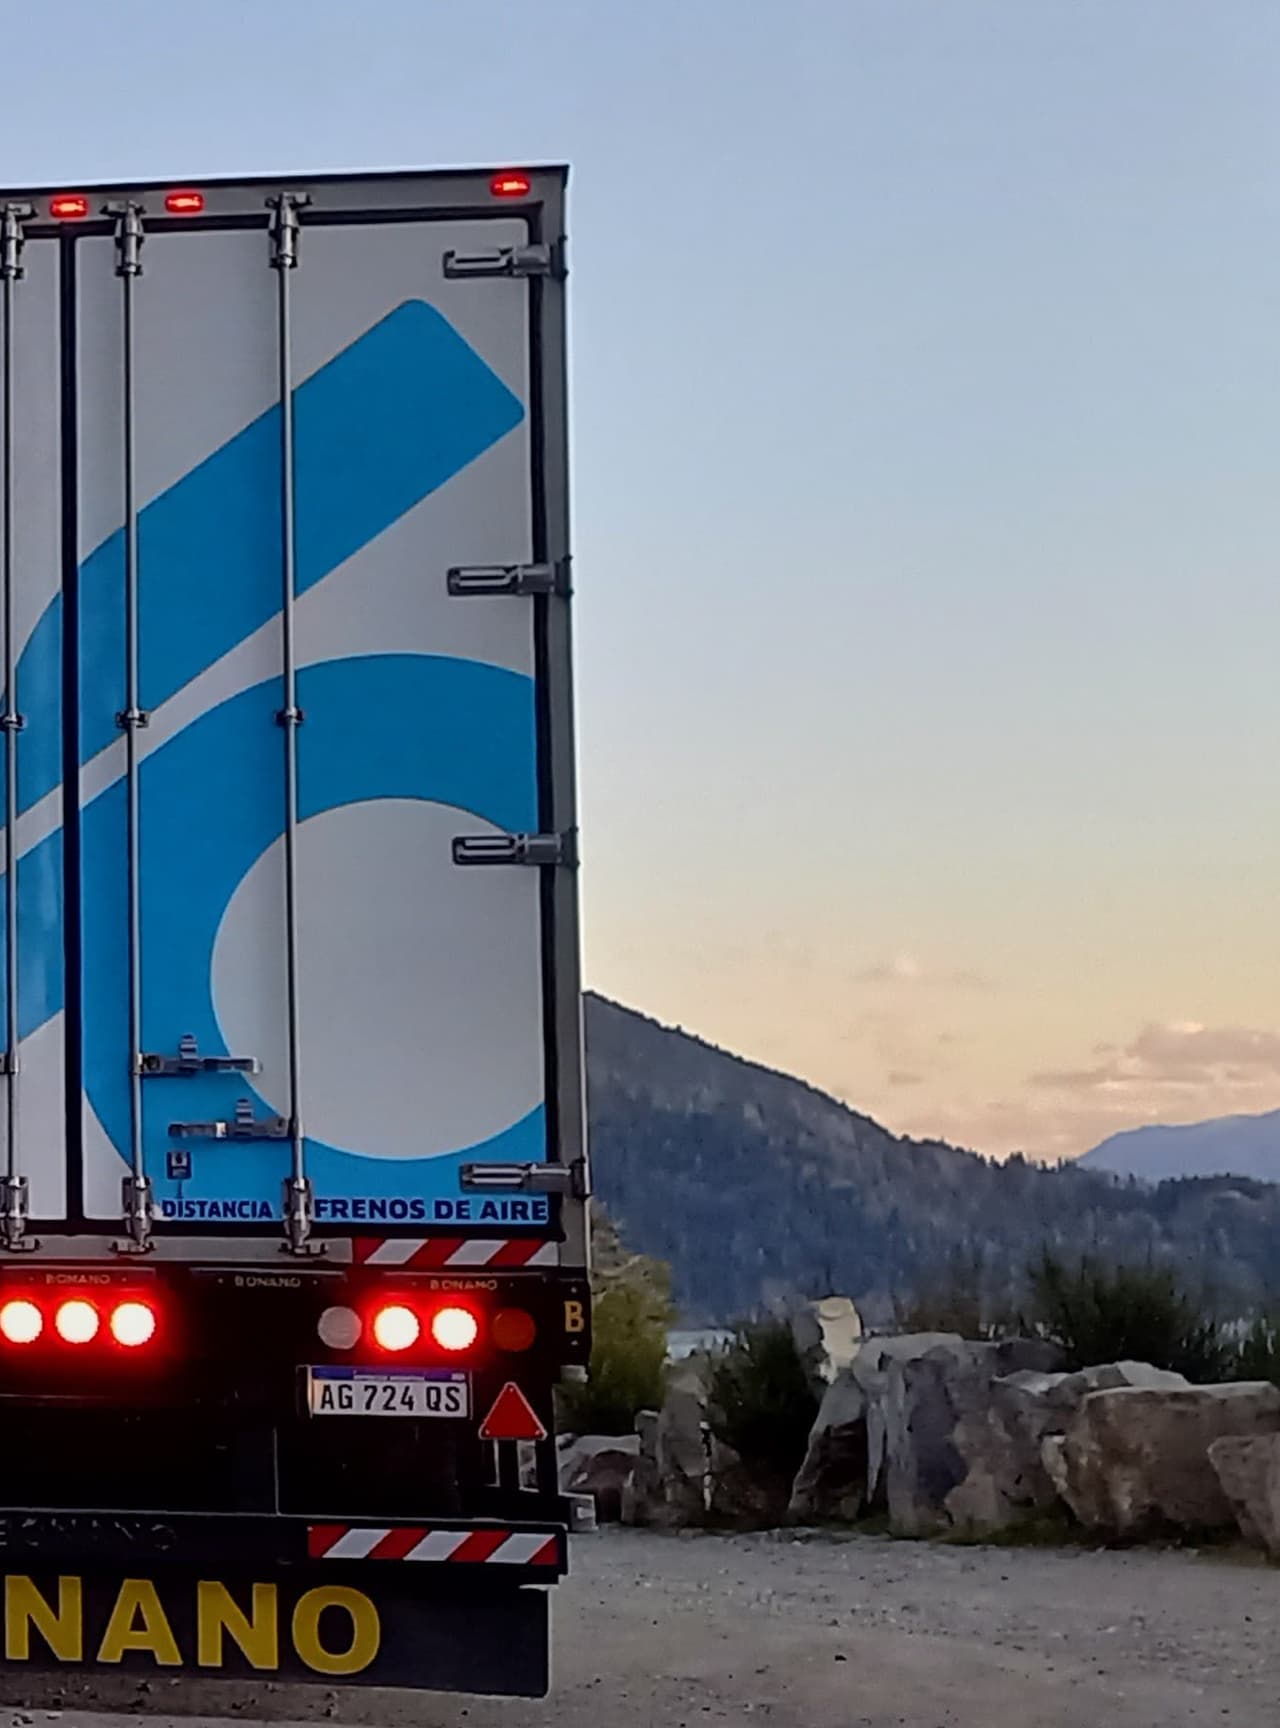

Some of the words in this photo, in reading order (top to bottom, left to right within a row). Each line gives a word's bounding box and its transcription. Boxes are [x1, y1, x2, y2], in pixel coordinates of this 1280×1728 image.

[162, 1200, 272, 1219] DISTANCIA
[315, 1199, 425, 1220] FRENOS
[434, 1200, 469, 1220] DE
[480, 1200, 548, 1221] AIRE
[564, 1301, 585, 1333] B
[320, 1384, 354, 1411] AG
[364, 1385, 415, 1412] 724
[425, 1386, 461, 1413] QS
